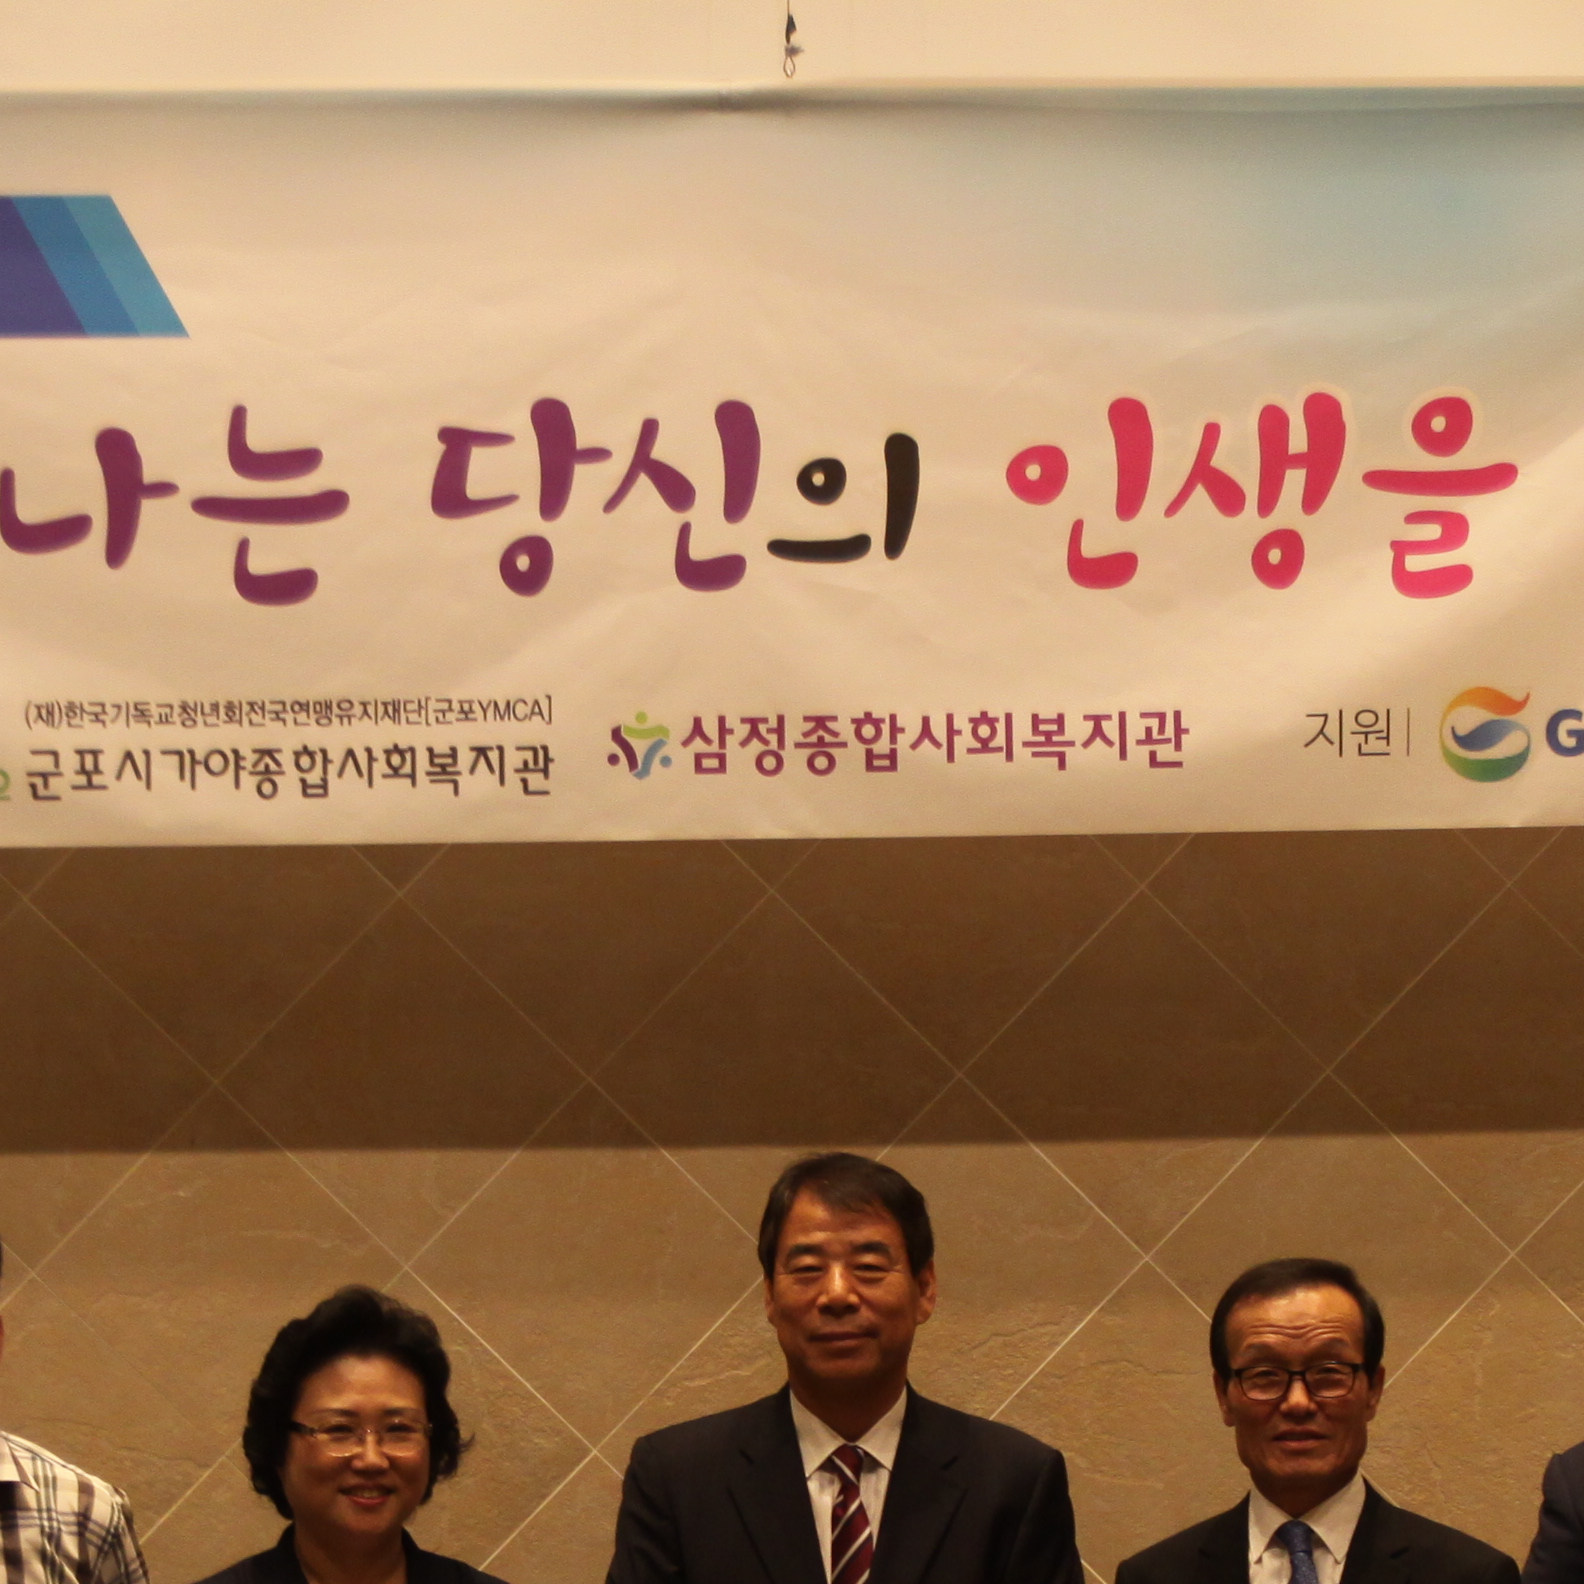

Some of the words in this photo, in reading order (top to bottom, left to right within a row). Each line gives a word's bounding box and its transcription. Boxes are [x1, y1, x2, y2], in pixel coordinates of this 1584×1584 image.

[430, 397, 921, 597] 당신의
[1005, 391, 1519, 600] 인생을
[680, 709, 1190, 777] 삼정종합사회복지관
[1303, 708, 1392, 759] 지원
[25, 743, 555, 802] 군포시가야종합사회복지관
